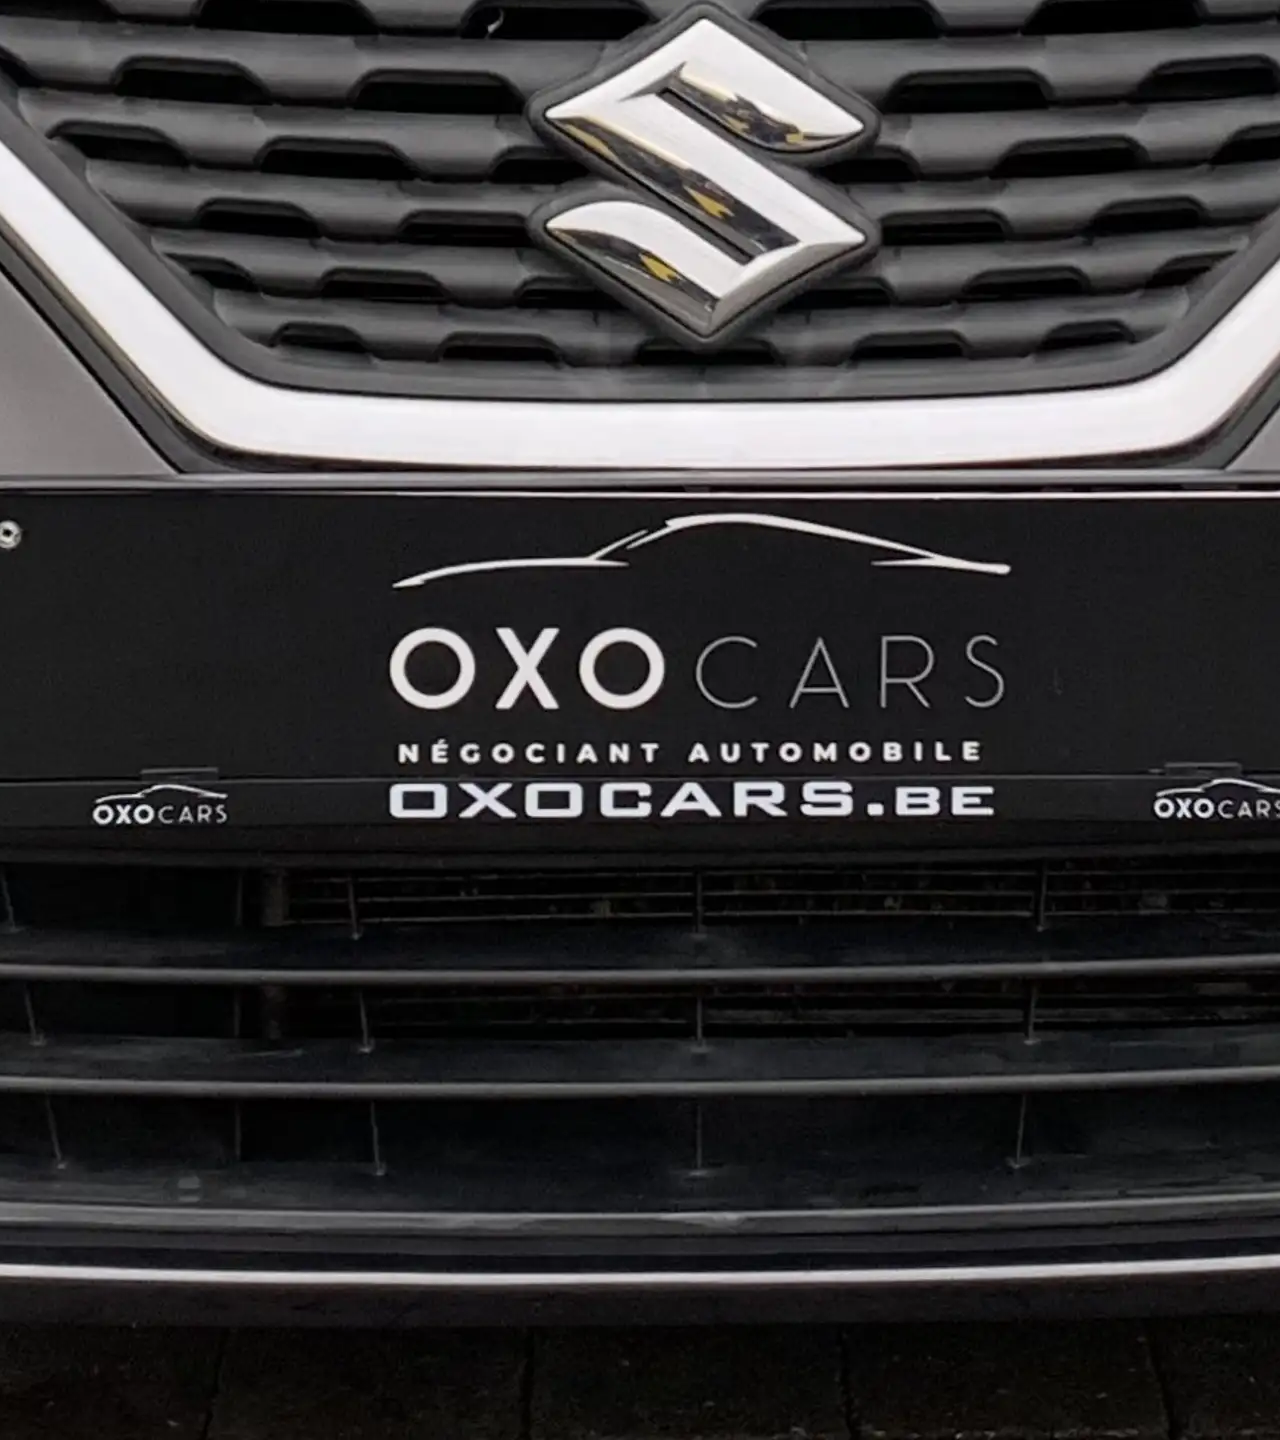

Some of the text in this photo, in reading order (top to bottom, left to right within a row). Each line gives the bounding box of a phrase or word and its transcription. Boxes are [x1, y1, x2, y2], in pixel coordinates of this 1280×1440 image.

[398, 738, 981, 764] NÉGOCIANT AUTOMOBILE
[389, 780, 995, 819] OXOCARS.BE
